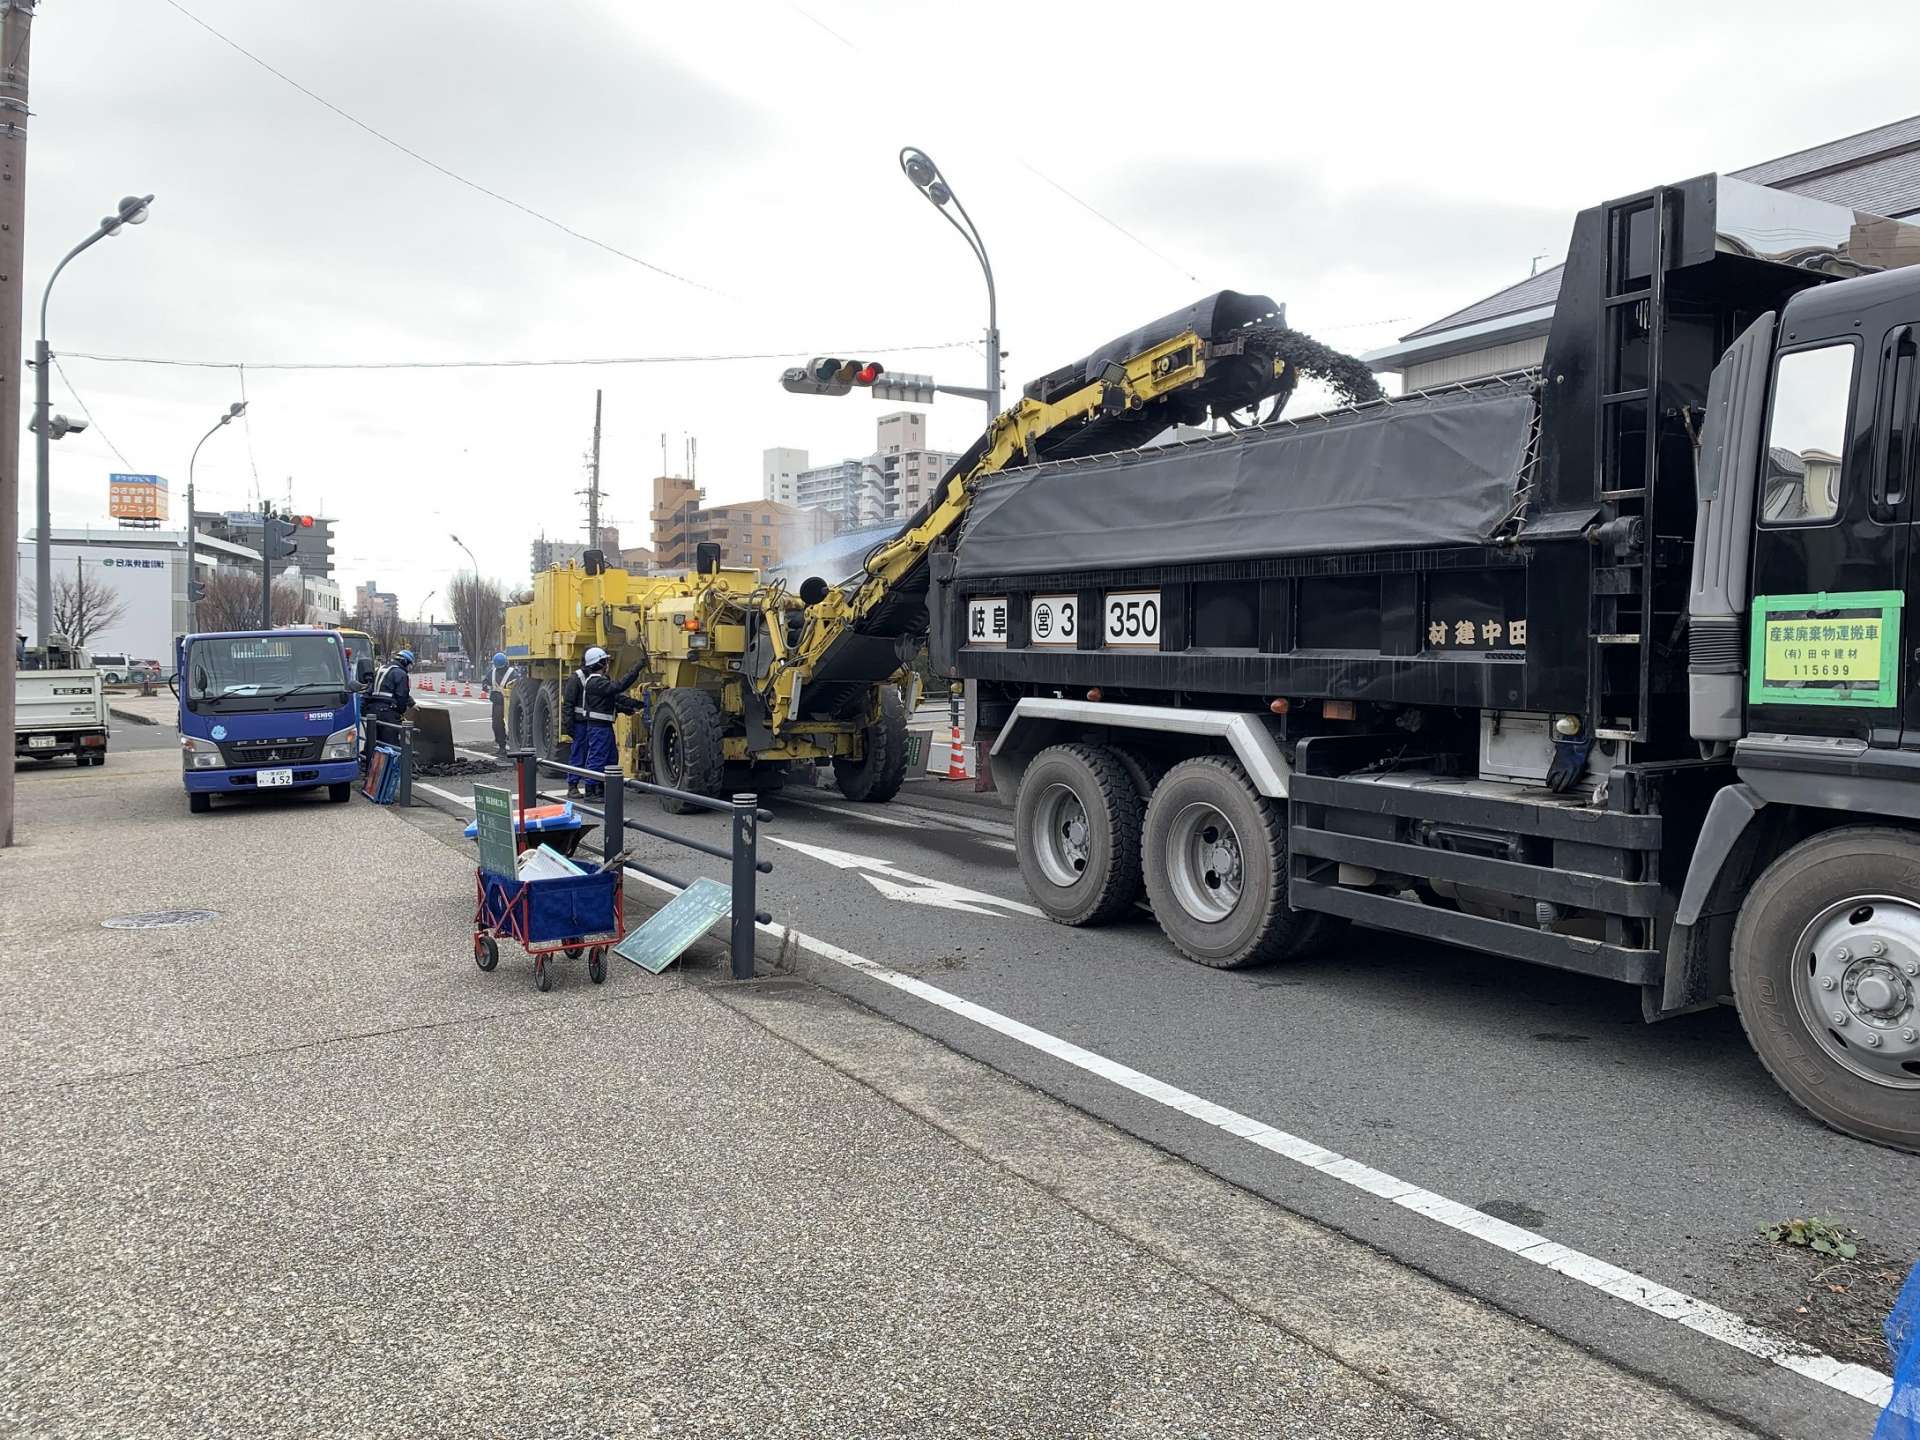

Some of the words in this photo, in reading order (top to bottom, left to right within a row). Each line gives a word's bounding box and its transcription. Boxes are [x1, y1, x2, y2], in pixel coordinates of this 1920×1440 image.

[1061, 603, 1075, 637] 3
[1110, 600, 1158, 637] 350
[1770, 625, 1879, 641] 産業廃棄物運搬車
[1793, 664, 1850, 676] 115699
[309, 711, 334, 719] NISHIO
[237, 737, 308, 746] FUSO
